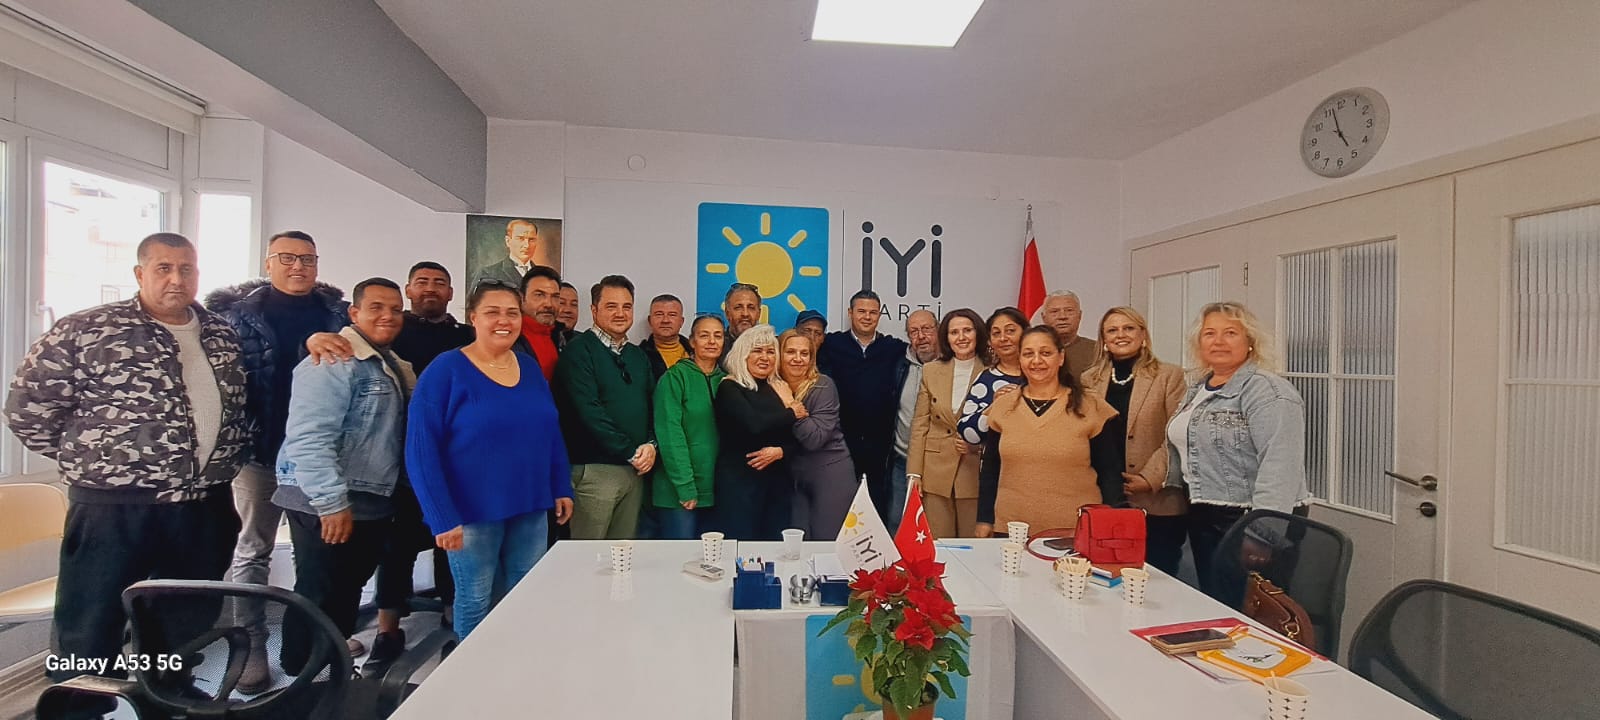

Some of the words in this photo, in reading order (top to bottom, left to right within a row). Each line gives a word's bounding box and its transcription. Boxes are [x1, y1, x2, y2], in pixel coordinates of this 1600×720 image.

[1337, 98, 1346, 110] 12
[1324, 108, 1332, 118] 11
[1362, 105, 1369, 115] 2
[1312, 122, 1324, 132] 10
[1366, 119, 1373, 128] 3
[1312, 138, 1318, 146] 9
[1362, 136, 1368, 144] 4
[1314, 150, 1320, 160] 8
[1352, 150, 1358, 158] 5
[1324, 158, 1330, 167] 7
[1337, 158, 1344, 167] 6
[879, 301, 942, 322] ARTİ
